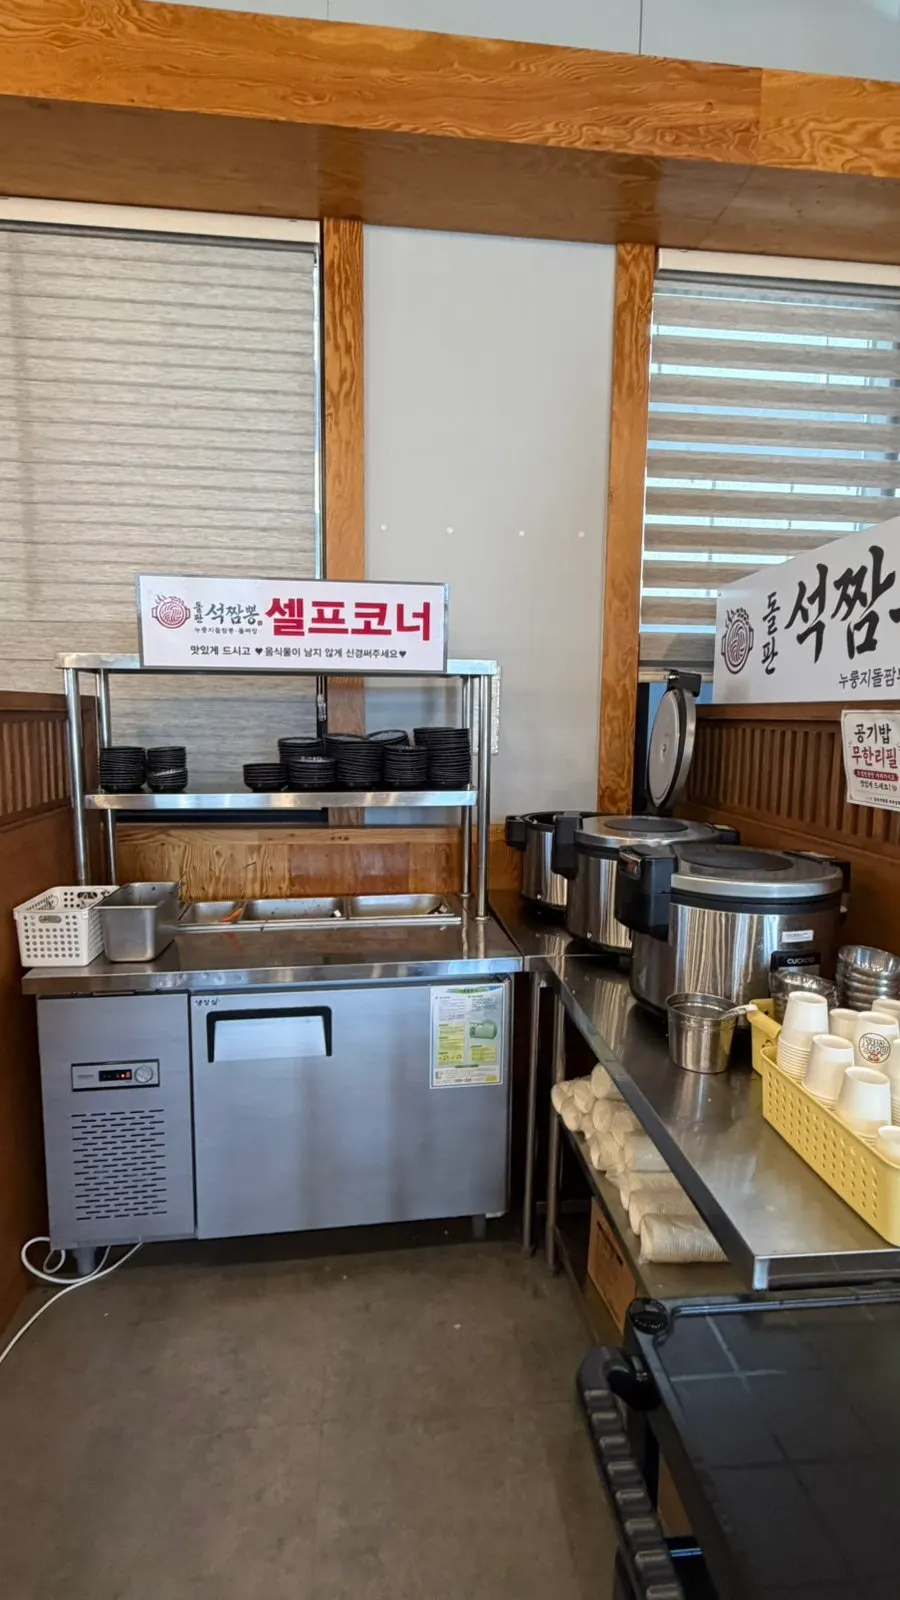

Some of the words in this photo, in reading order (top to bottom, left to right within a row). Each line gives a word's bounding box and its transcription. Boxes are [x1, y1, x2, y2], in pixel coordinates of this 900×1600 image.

[193, 601, 203, 624] 돌판
[205, 602, 260, 625] 석짬뽕
[784, 545, 900, 664] 석짬
[265, 597, 431, 641] 셀프코너
[761, 591, 781, 675] 돌판
[190, 645, 219, 656] 맛있게
[222, 646, 251, 656] 드시고
[265, 647, 300, 657] 음식물이
[303, 648, 321, 658] 남지
[324, 648, 342, 658] 않게
[346, 648, 398, 659] 신경써주세요
[854, 723, 892, 745] 공기밥
[851, 745, 898, 769] 무한리필
